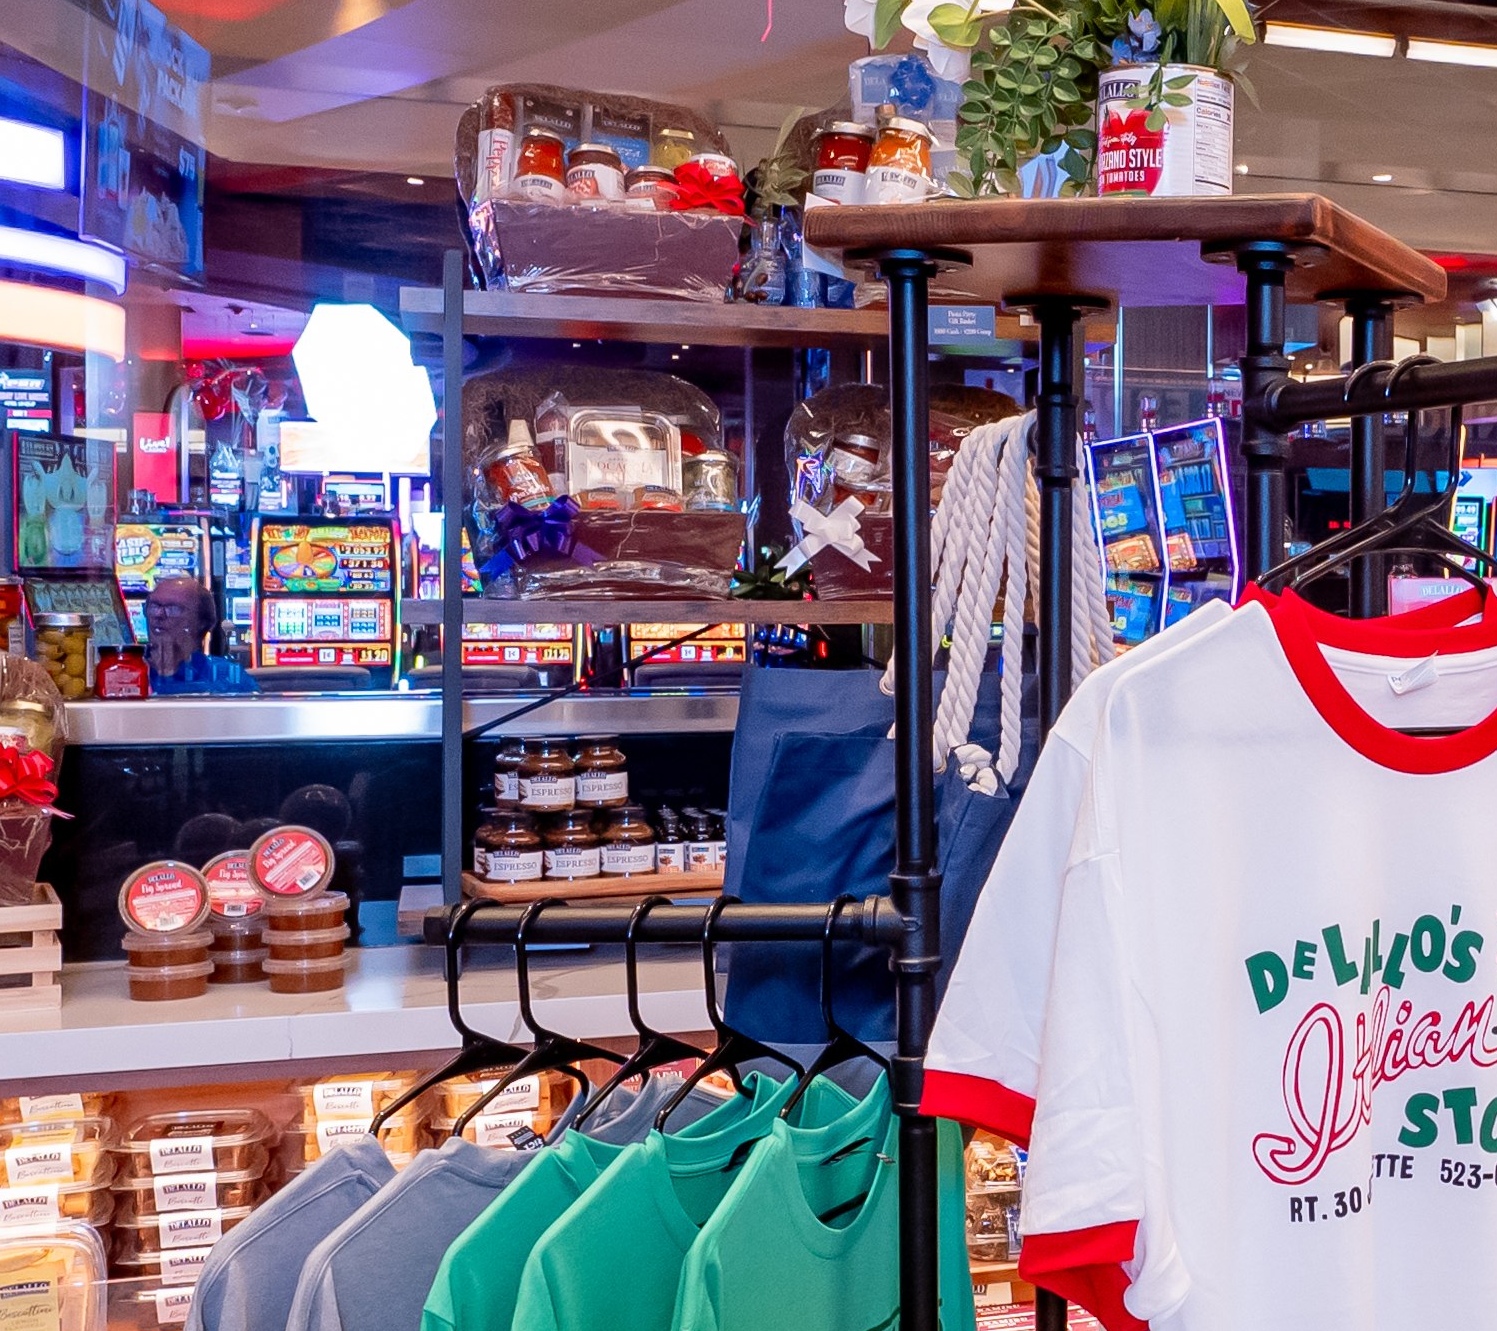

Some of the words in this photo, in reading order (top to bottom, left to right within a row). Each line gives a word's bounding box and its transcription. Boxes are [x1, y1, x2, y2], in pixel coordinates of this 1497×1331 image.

[1129, 149, 1162, 168] STYLE
[1107, 171, 1145, 184] TOMATOES
[531, 787, 572, 796] ESPRESSO
[607, 855, 648, 864] ESPRESSO
[142, 884, 154, 893] Fig
[156, 880, 182, 892] Spread
[158, 1144, 202, 1157] DELALLO
[1290, 1196, 1329, 1222] RT.
[1334, 1187, 1362, 1219] 30
